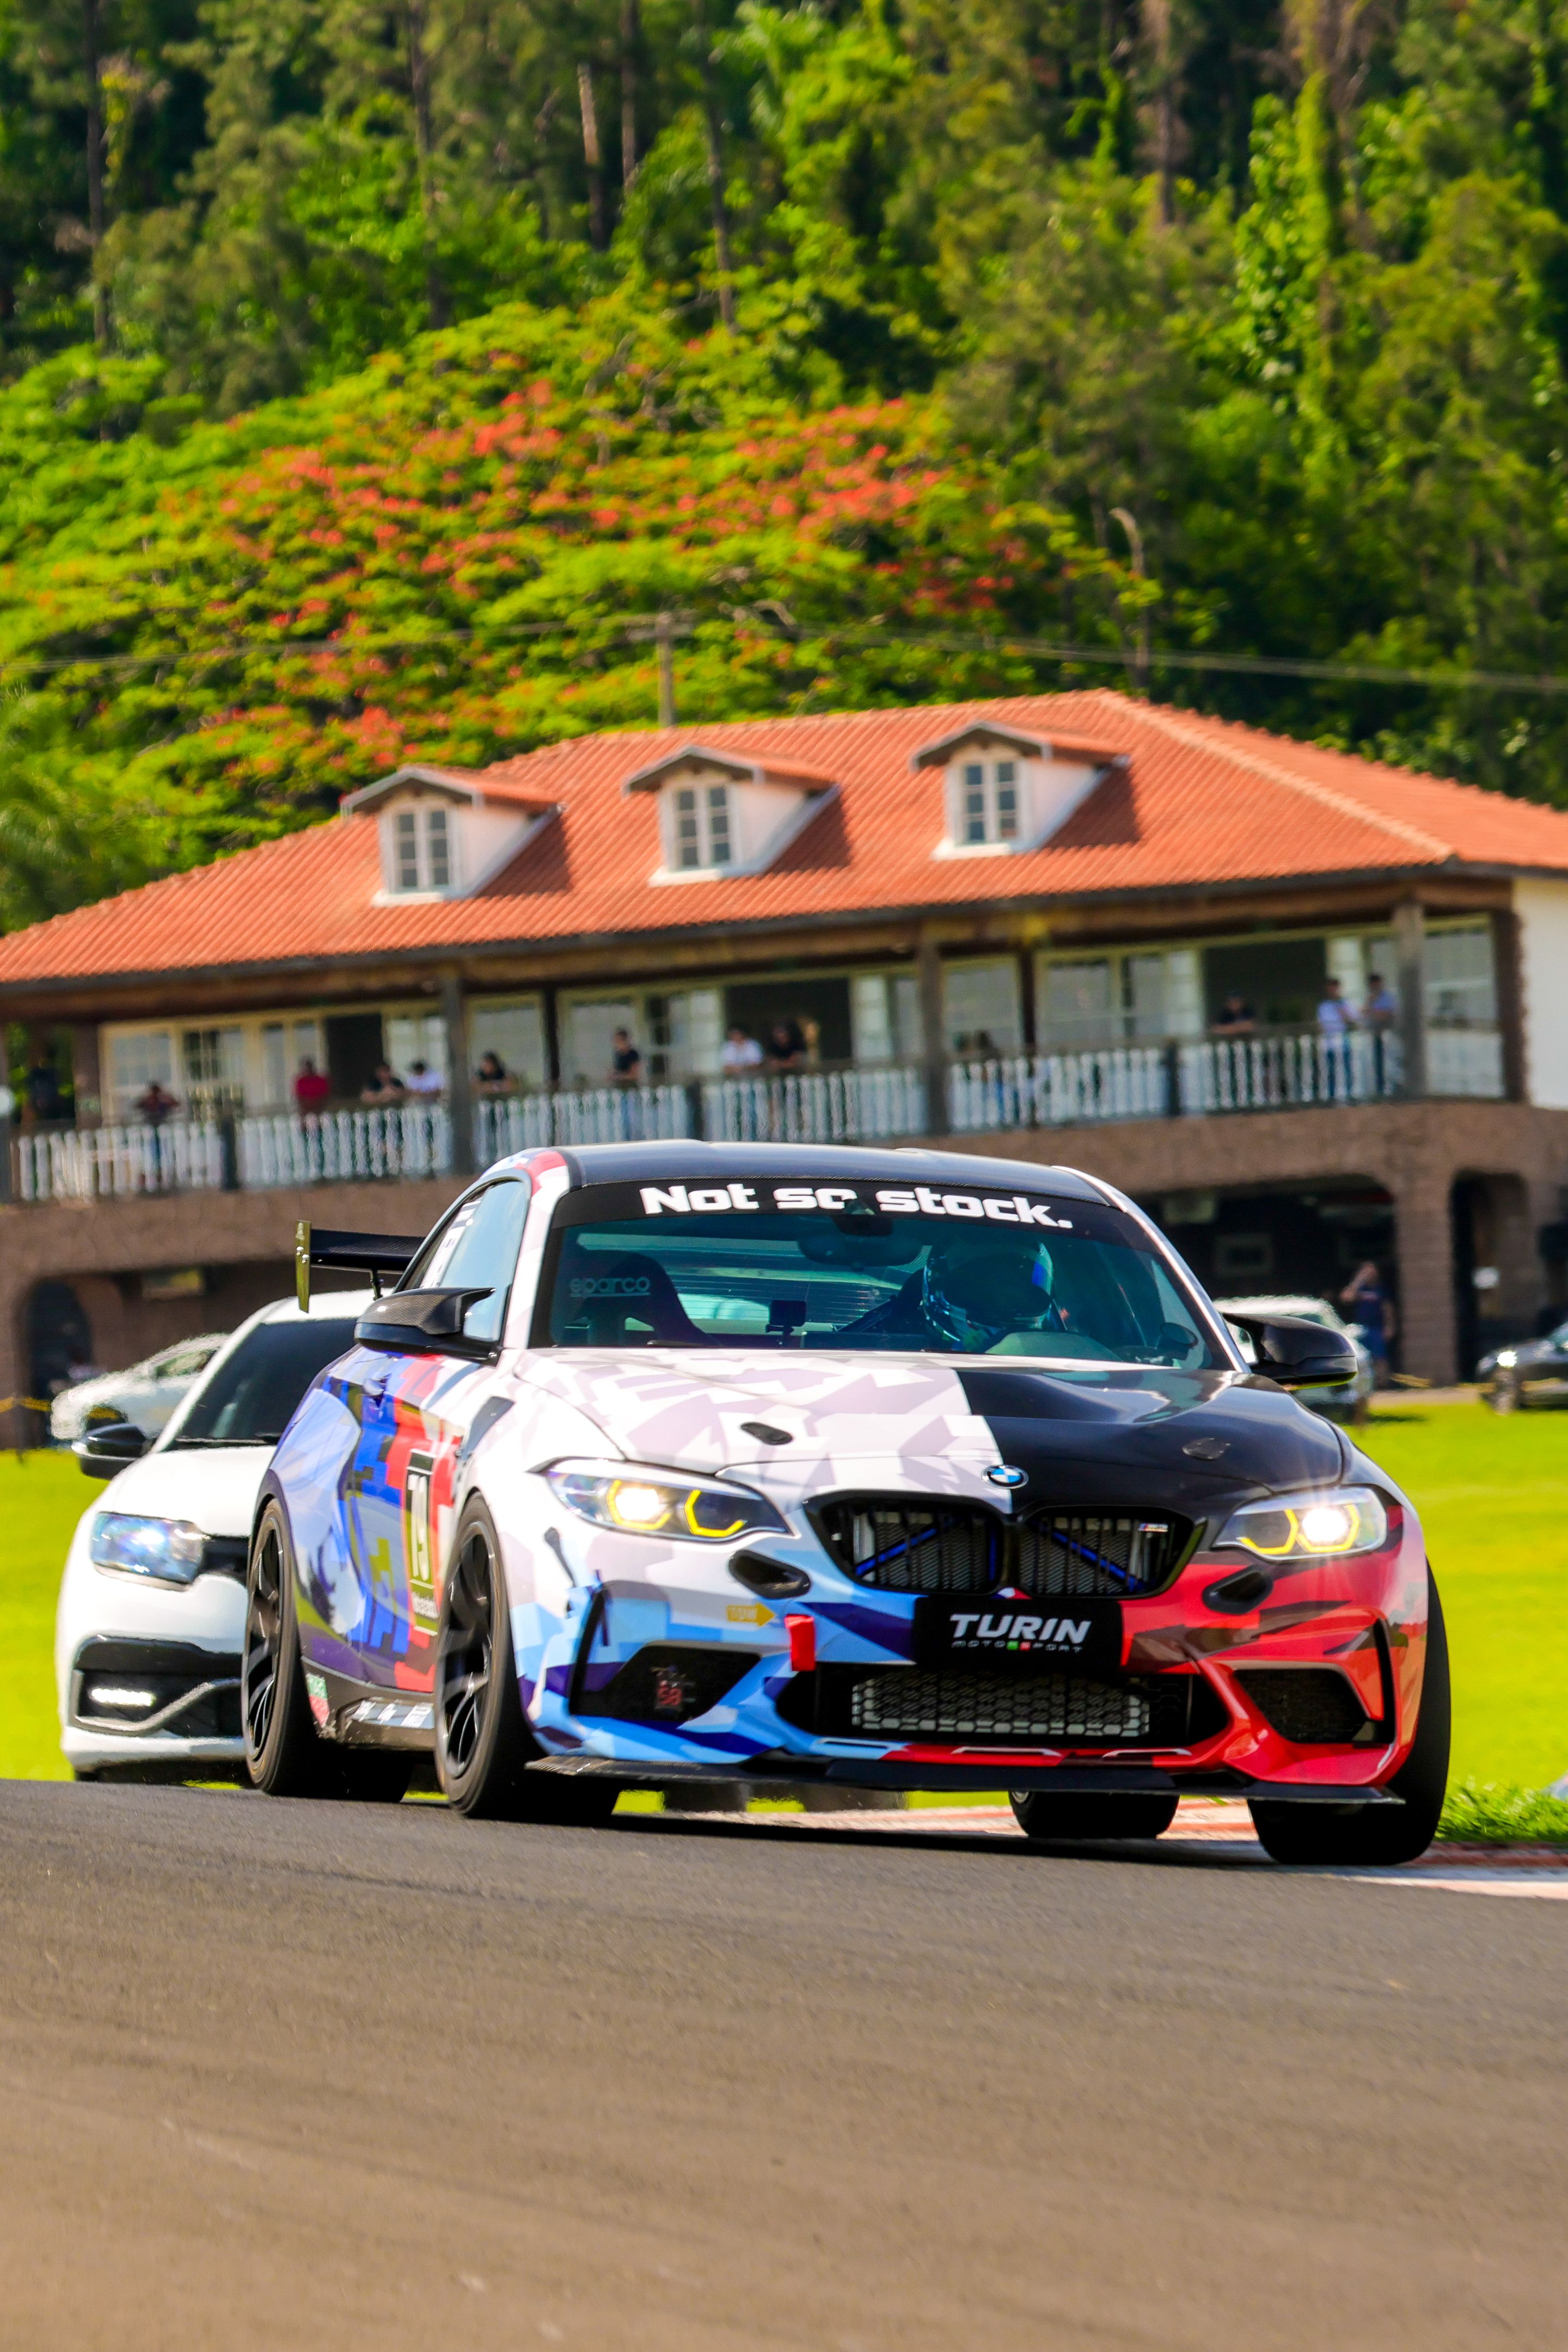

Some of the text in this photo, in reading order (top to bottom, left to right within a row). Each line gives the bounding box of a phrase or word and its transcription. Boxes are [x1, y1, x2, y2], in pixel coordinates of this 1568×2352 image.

[639, 1183, 760, 1215] Not
[875, 1187, 1073, 1229] stock.
[570, 1276, 651, 1295] sparco
[950, 1613, 1092, 1644] TURIN
